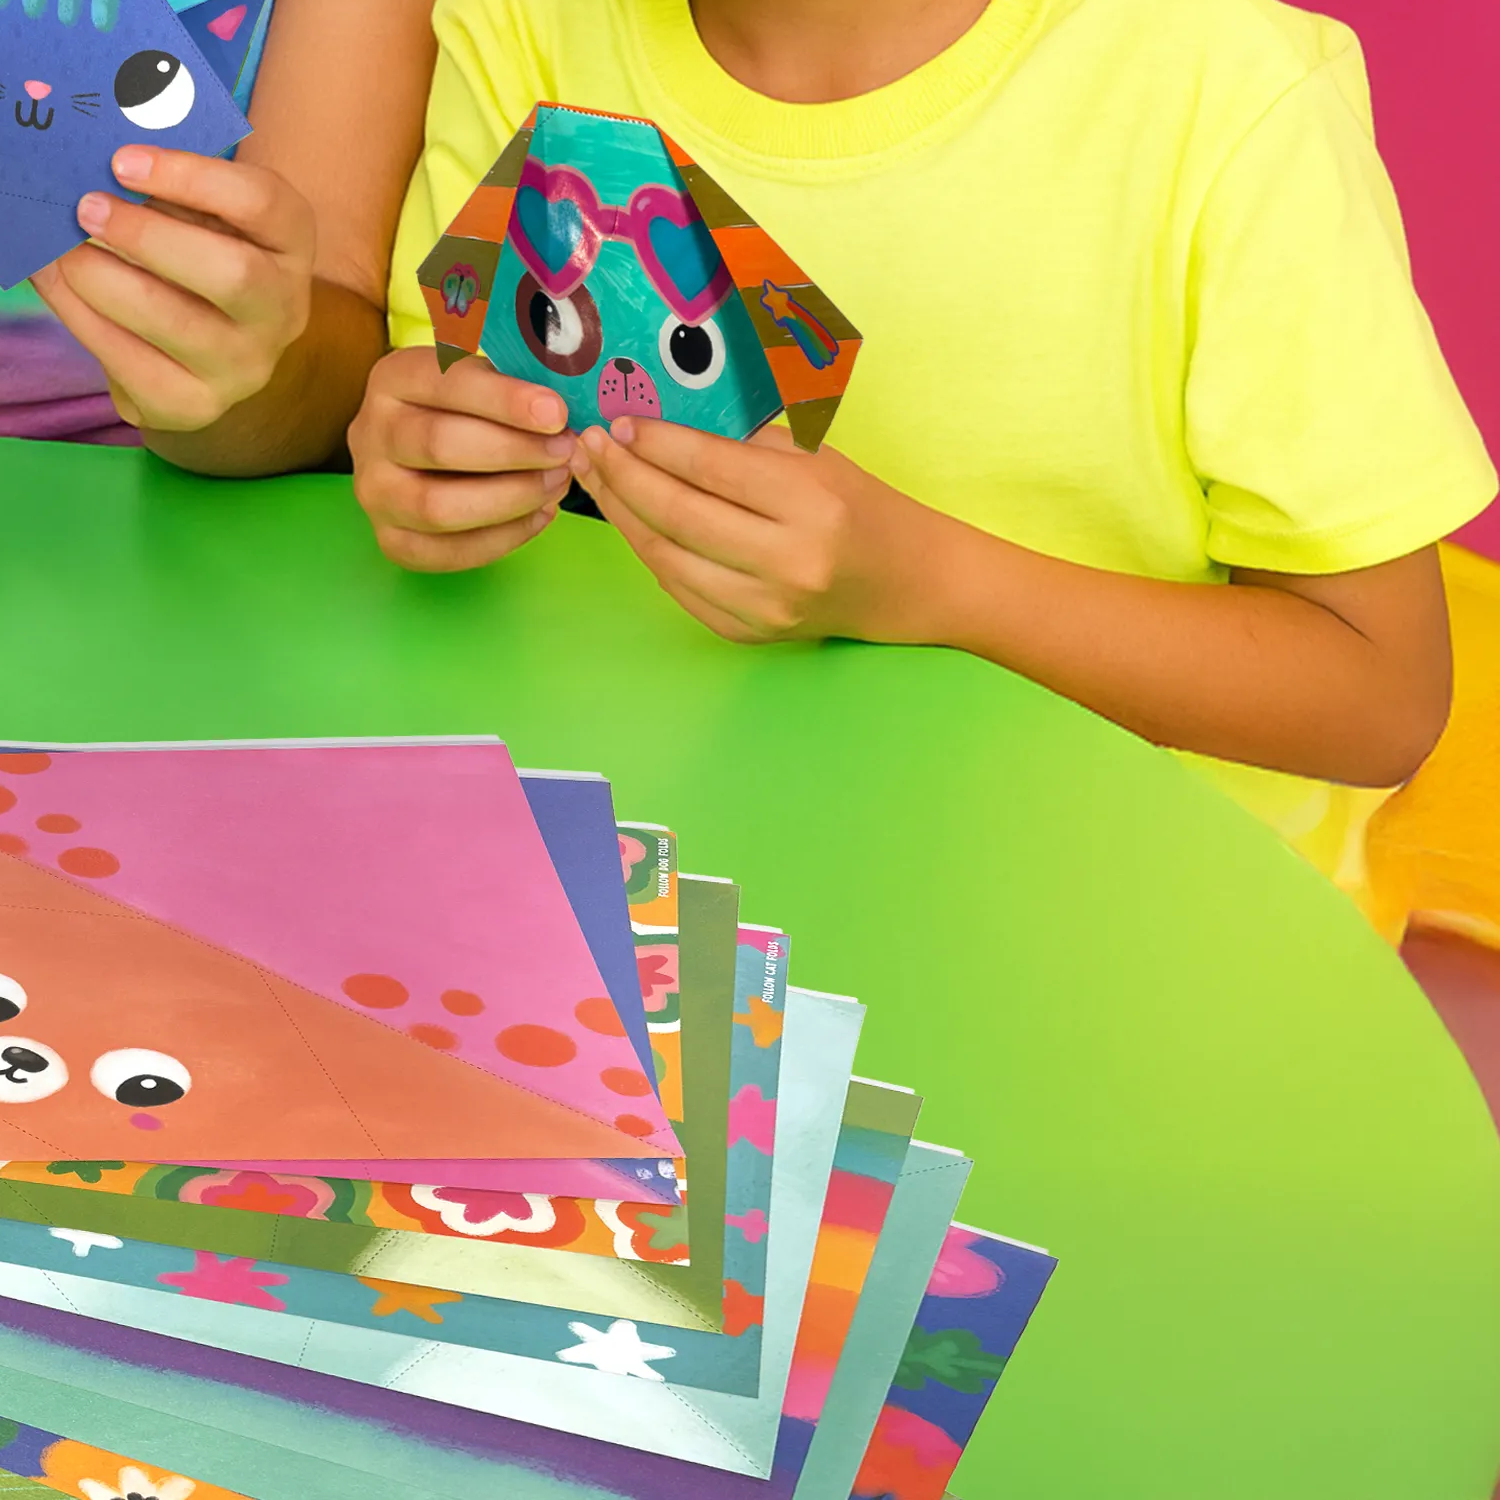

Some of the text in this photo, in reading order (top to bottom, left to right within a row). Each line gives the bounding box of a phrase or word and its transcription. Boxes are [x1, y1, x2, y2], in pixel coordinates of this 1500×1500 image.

[658, 838, 669, 898] FOLLOW DOG FOLDS
[761, 941, 779, 1004] FOLLOW CAT FOLDS
